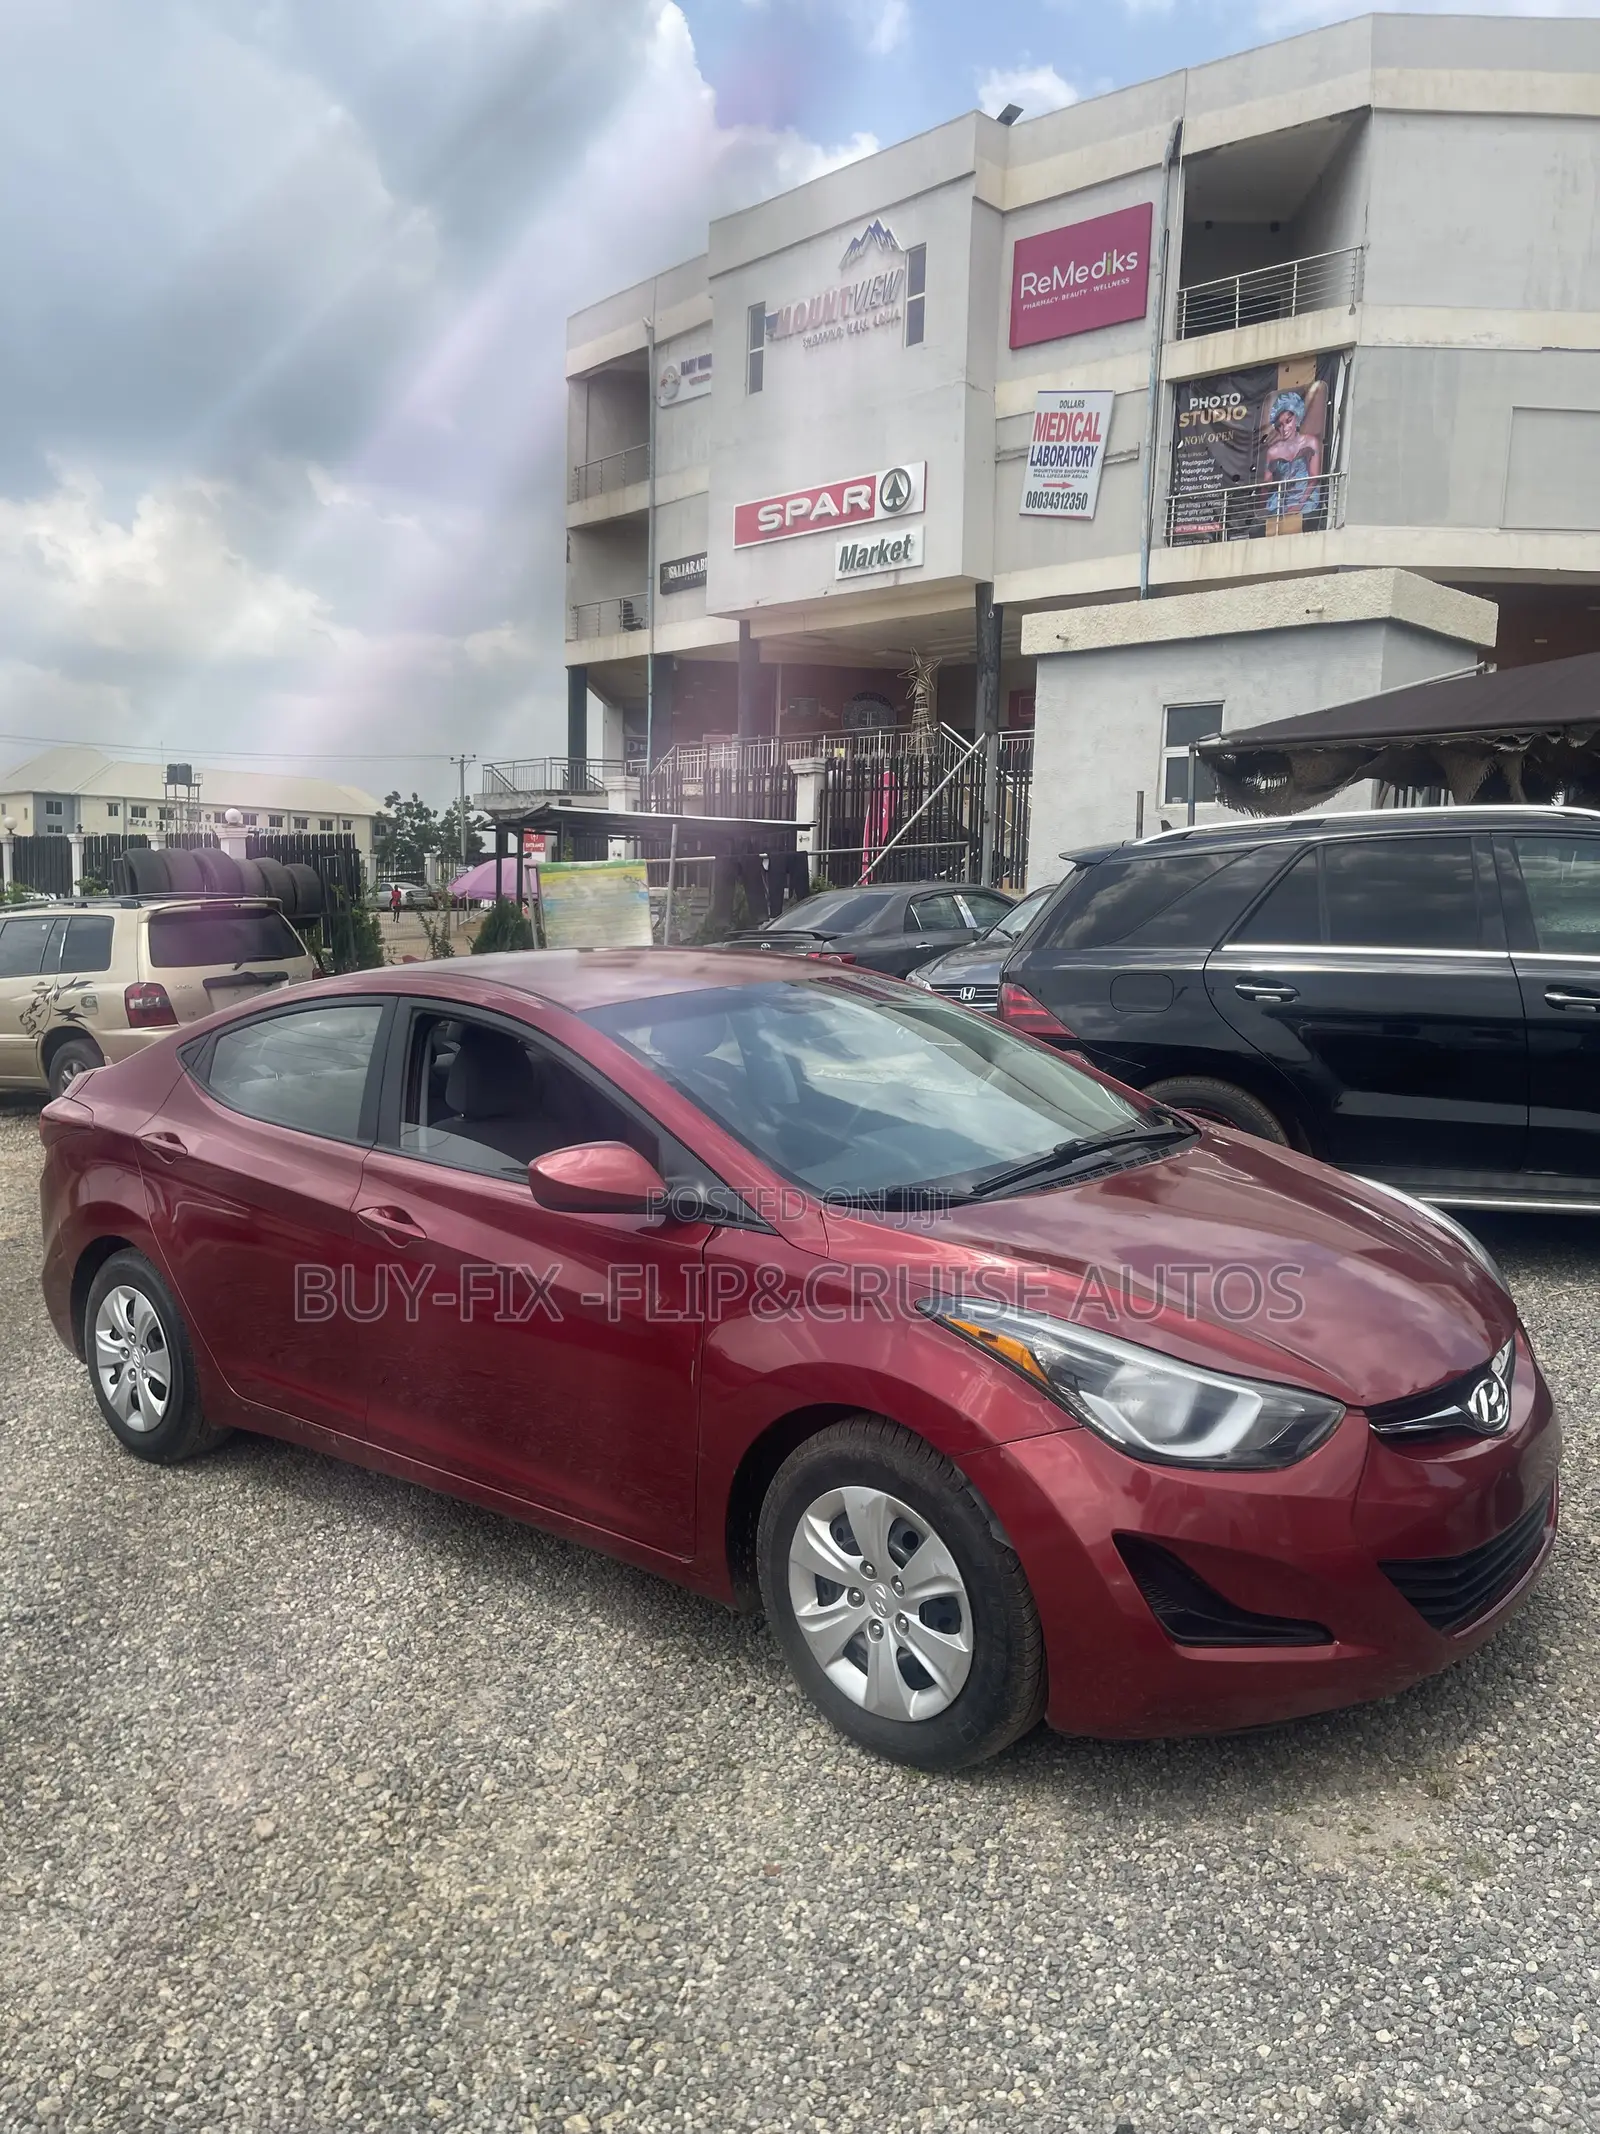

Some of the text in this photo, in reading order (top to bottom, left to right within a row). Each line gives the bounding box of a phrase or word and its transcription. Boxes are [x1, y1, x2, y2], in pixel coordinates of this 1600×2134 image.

[1020, 249, 1138, 299] ReMediks
[1022, 277, 1130, 311] PHARMACY BEAUTY WELLNESS
[1059, 399, 1085, 409] DOLLARS
[1189, 392, 1242, 411] PHOTO
[1033, 412, 1102, 443] MEDICAL
[1179, 405, 1248, 428] STUDIO
[1184, 430, 1235, 446] NOW OPEN
[1030, 445, 1099, 468] LABORATORY
[758, 484, 872, 532] SPAR
[1025, 491, 1089, 510] 08034312350
[838, 533, 914, 572] Market
